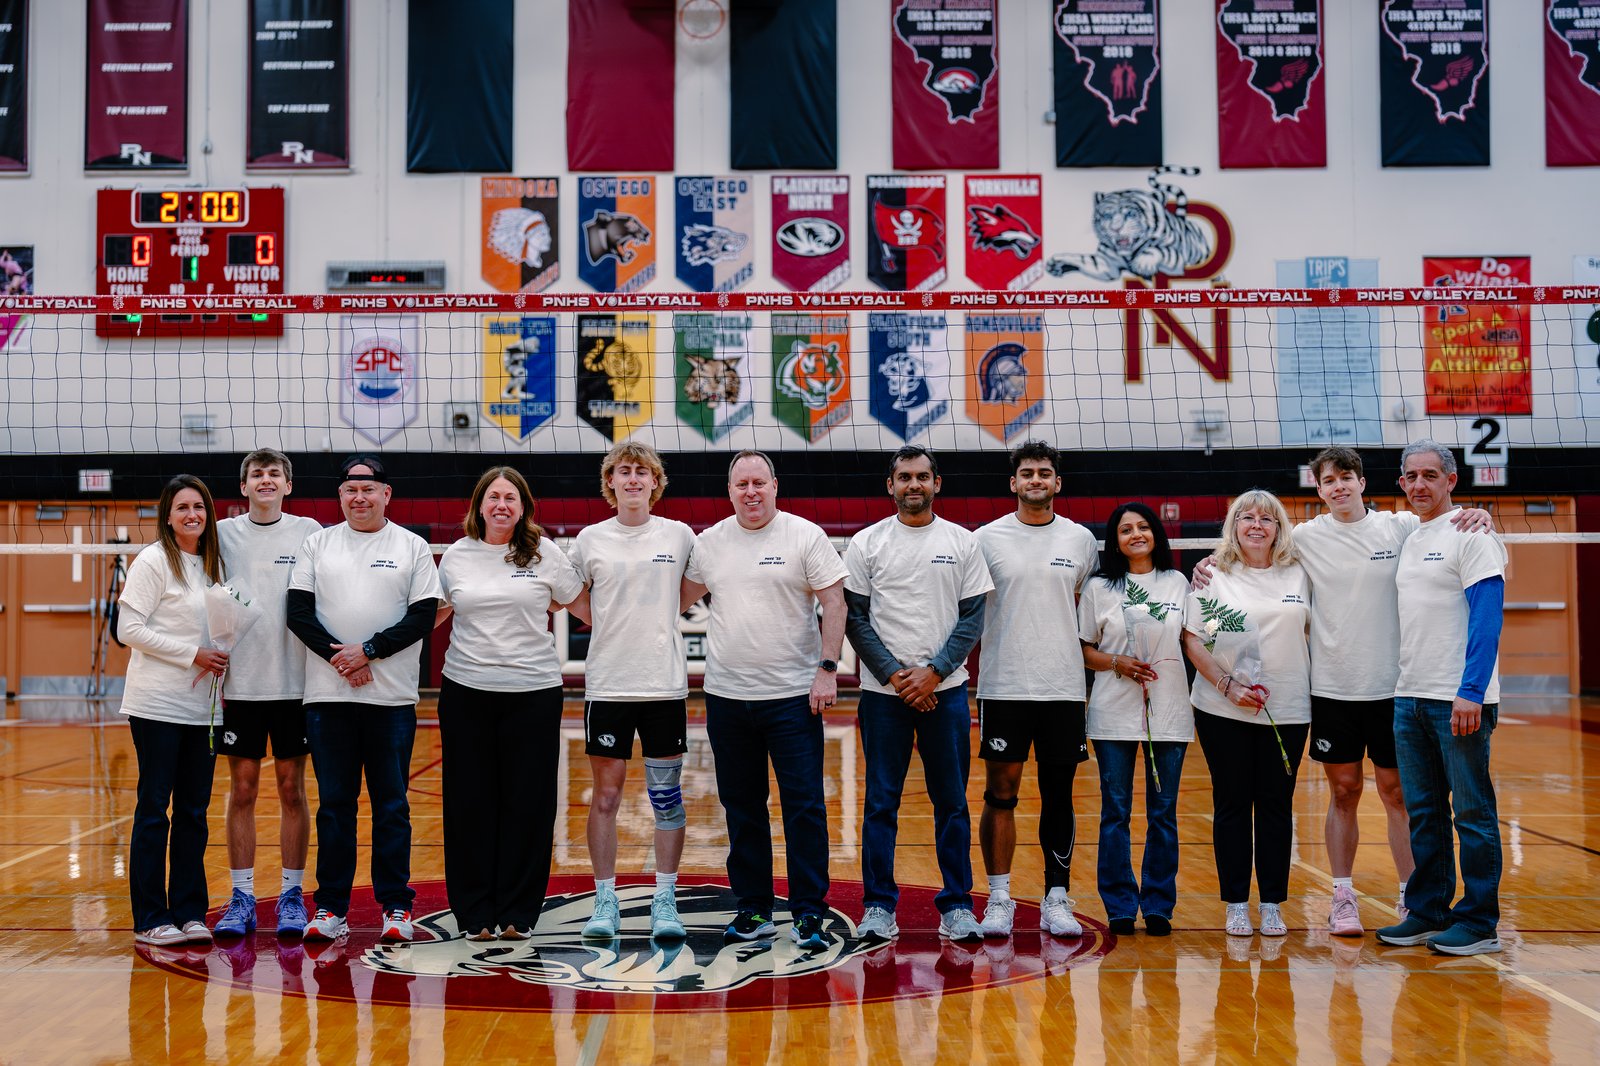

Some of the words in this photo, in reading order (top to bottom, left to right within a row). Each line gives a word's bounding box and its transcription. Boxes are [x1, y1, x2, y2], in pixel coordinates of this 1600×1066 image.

[582, 178, 650, 198] OSWEGO
[678, 178, 747, 196] OSWEGO
[693, 195, 738, 211] EAST
[132, 235, 150, 266] 0
[170, 244, 209, 257] PERIOD
[256, 234, 274, 265] 0
[107, 266, 149, 283] HOME
[223, 265, 280, 282] VISITOR
[1307, 259, 1347, 279] TRIP'S
[1481, 257, 1511, 276] Do
[341, 297, 387, 308] PNHS
[392, 297, 498, 308] VOLLEYBALL
[542, 296, 590, 307] PNHS
[595, 296, 701, 307] VOLLEYBALL
[745, 295, 793, 306] PNHS
[799, 295, 905, 306] VOLLEYBALL
[950, 294, 998, 305] PNHS
[1003, 294, 1109, 305] VOLLEYBALL
[1154, 292, 1201, 303] PNHS
[1206, 292, 1313, 303] VOLLEYBALL
[1357, 291, 1404, 302] PNHS
[1410, 290, 1518, 301] VOLLEYBALL
[1562, 289, 1600, 300] PNH
[140, 298, 187, 309] PNHS
[192, 298, 297, 309] VOLLEYBALL
[354, 348, 404, 372] SPC
[1440, 345, 1519, 360] Winning
[1429, 357, 1530, 374] Attitude!
[1471, 418, 1501, 454] 2
